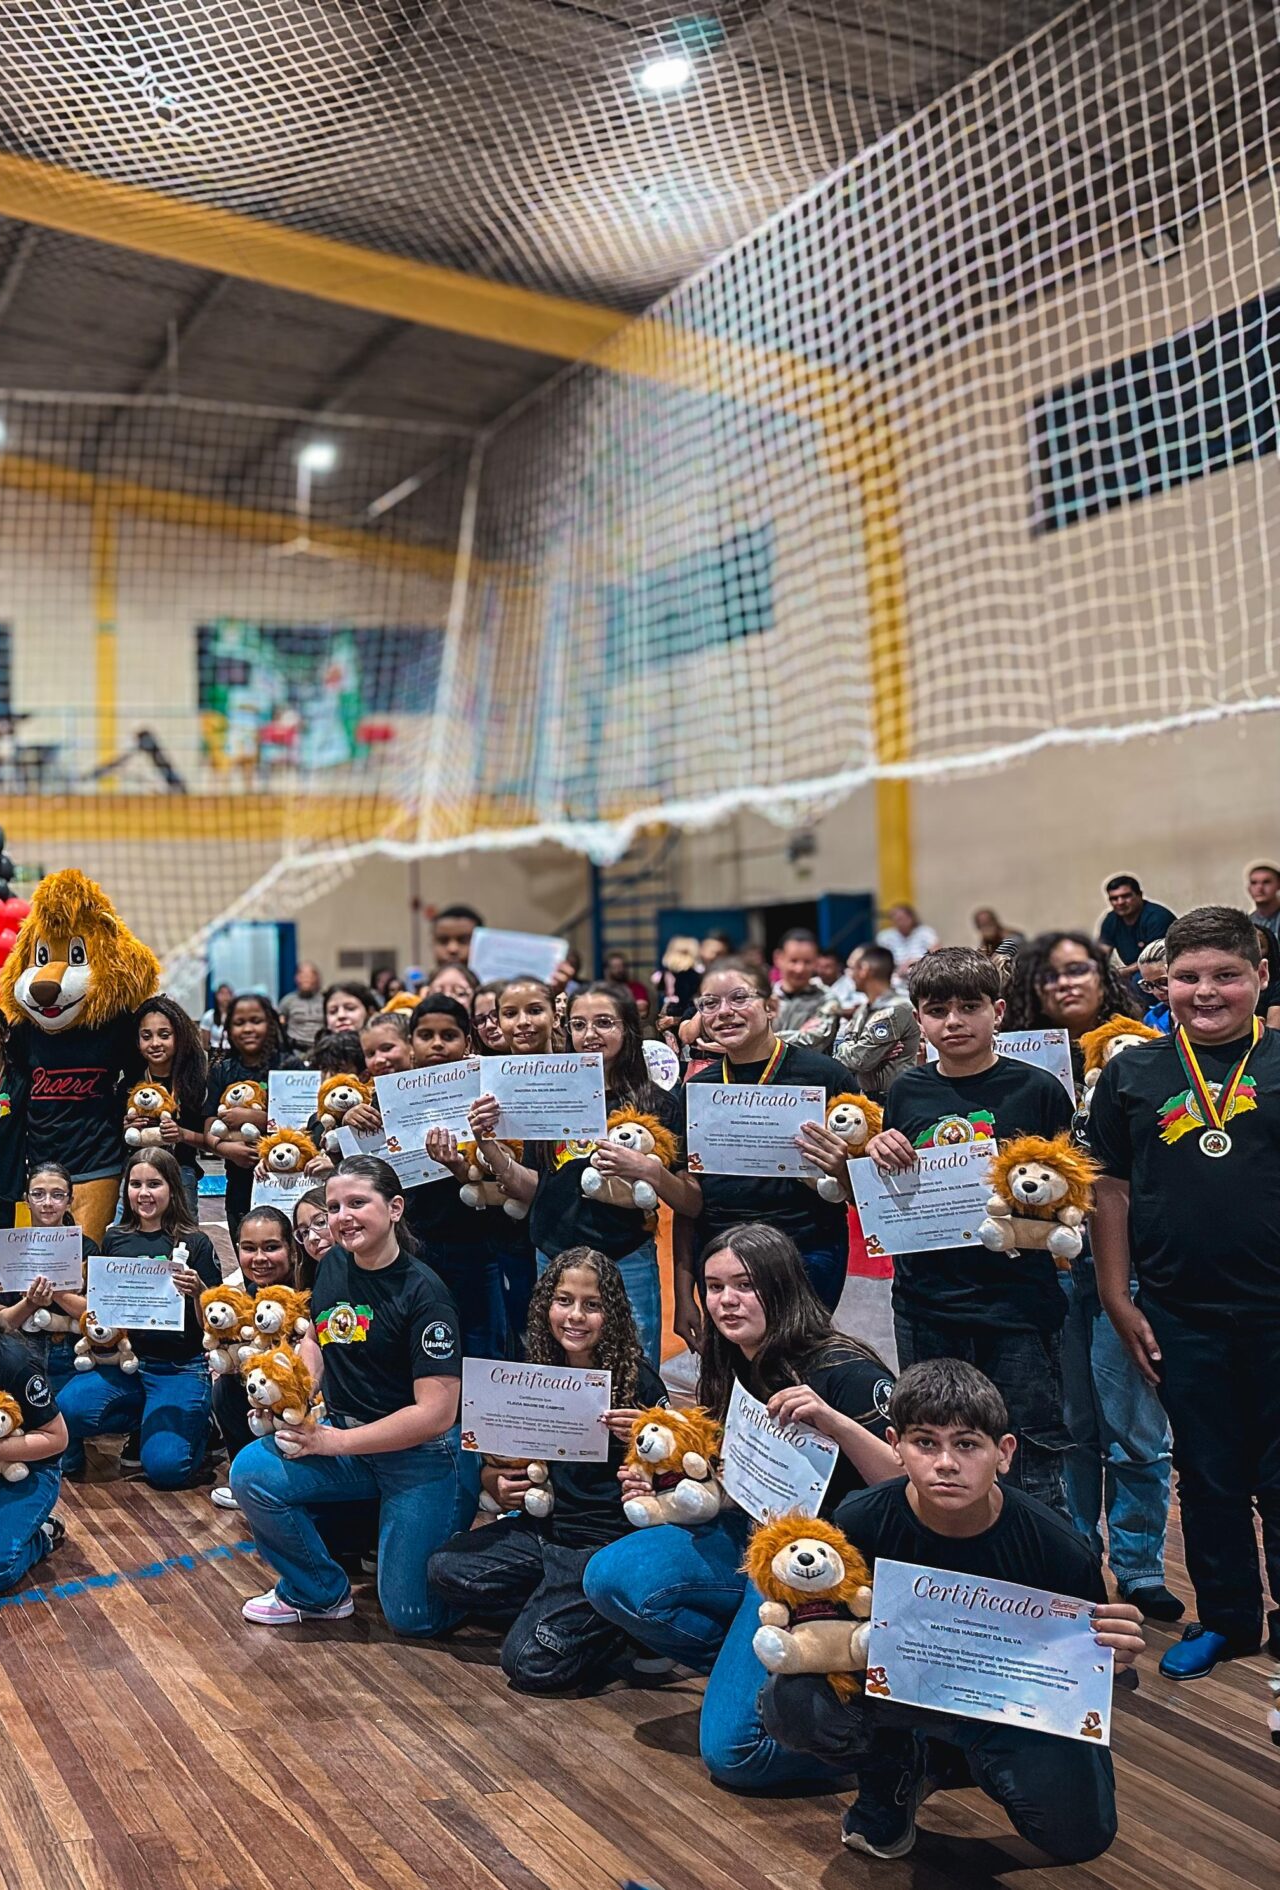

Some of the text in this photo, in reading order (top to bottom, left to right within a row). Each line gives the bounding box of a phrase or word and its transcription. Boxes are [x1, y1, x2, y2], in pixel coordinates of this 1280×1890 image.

[397, 1068, 466, 1090] Certificado
[501, 1060, 578, 1076] Certificado
[713, 1089, 797, 1108] Certificado
[8, 1232, 64, 1243] Certificado
[107, 1261, 167, 1275] Certificado
[491, 1367, 582, 1392] Certificado
[738, 1396, 807, 1449] Certificado
[914, 1575, 1044, 1619] Certificado
[930, 1623, 1022, 1646] MATHEUS HAUBERT DA SILVA
